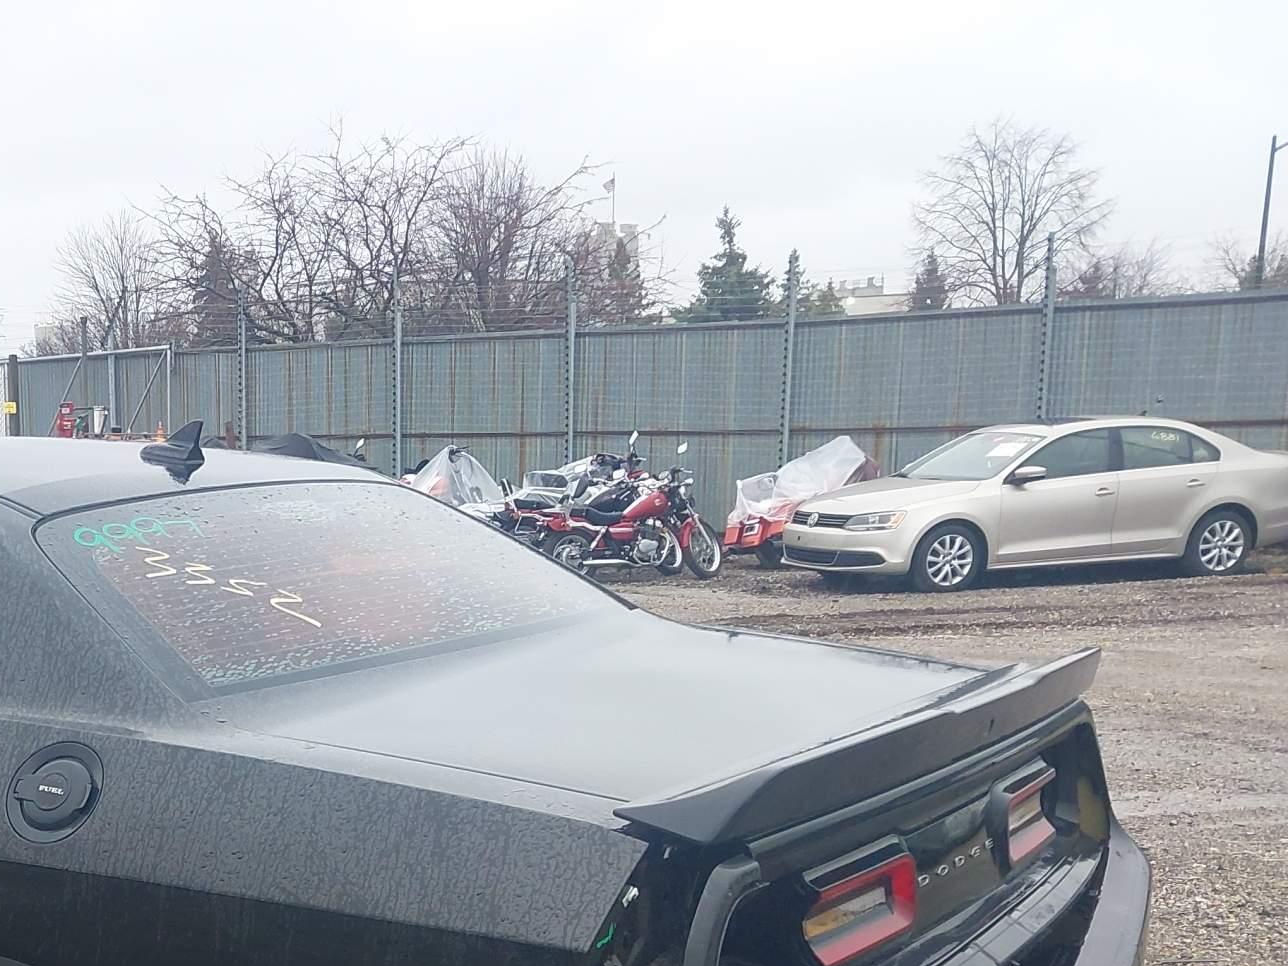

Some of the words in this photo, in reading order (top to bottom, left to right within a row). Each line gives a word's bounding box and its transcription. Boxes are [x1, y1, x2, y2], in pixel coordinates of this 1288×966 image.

[135, 546, 323, 629] 3352
[38, 784, 65, 796] FUEL
[918, 838, 994, 888] DODGE
